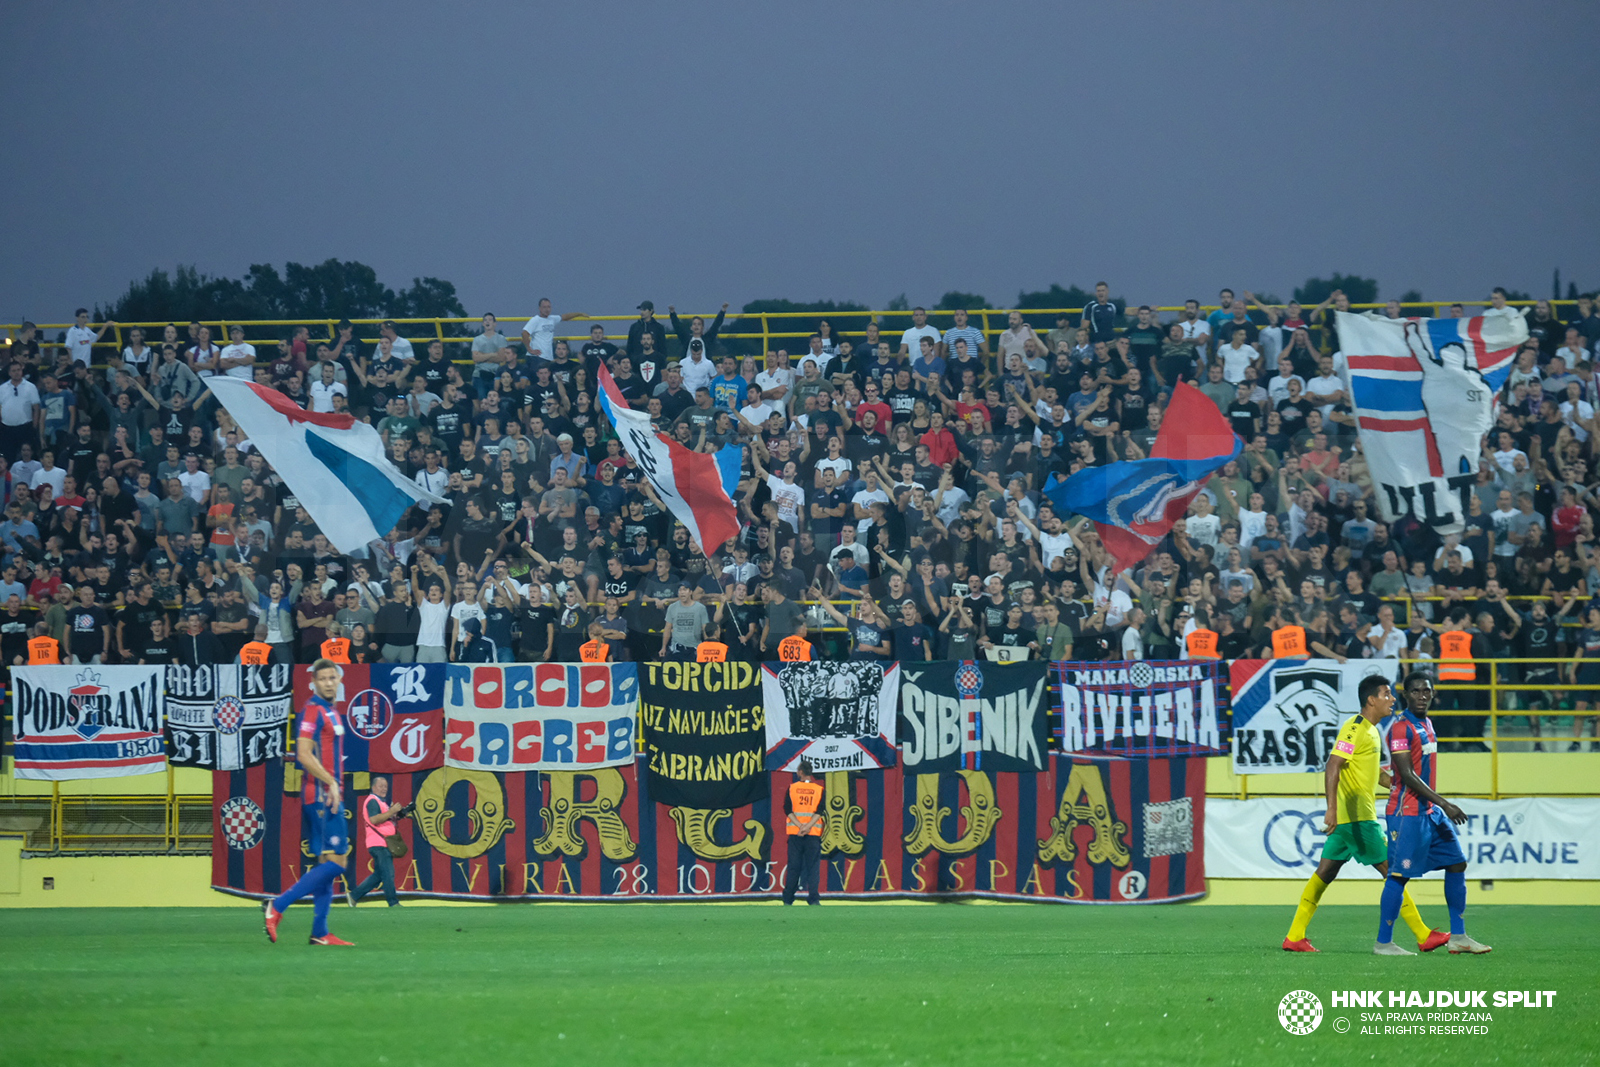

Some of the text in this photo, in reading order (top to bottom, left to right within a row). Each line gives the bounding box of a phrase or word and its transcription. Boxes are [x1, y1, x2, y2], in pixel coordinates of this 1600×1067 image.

[37, 649, 50, 659] 116
[783, 645, 801, 660] 683
[445, 662, 639, 709] TORCIDA
[16, 672, 160, 740] PODSTRANA
[668, 704, 749, 736] NAVIJAČE
[902, 669, 1046, 770] ŠIBENIK
[1062, 678, 1220, 752] RIVIJERA
[116, 737, 160, 758] 1950
[446, 718, 633, 765] ZAGREB
[825, 745, 839, 753] 2017
[221, 798, 261, 816] HAJDUK
[799, 796, 814, 806] 291
[612, 863, 655, 896] 28.
[677, 863, 712, 894] 10.
